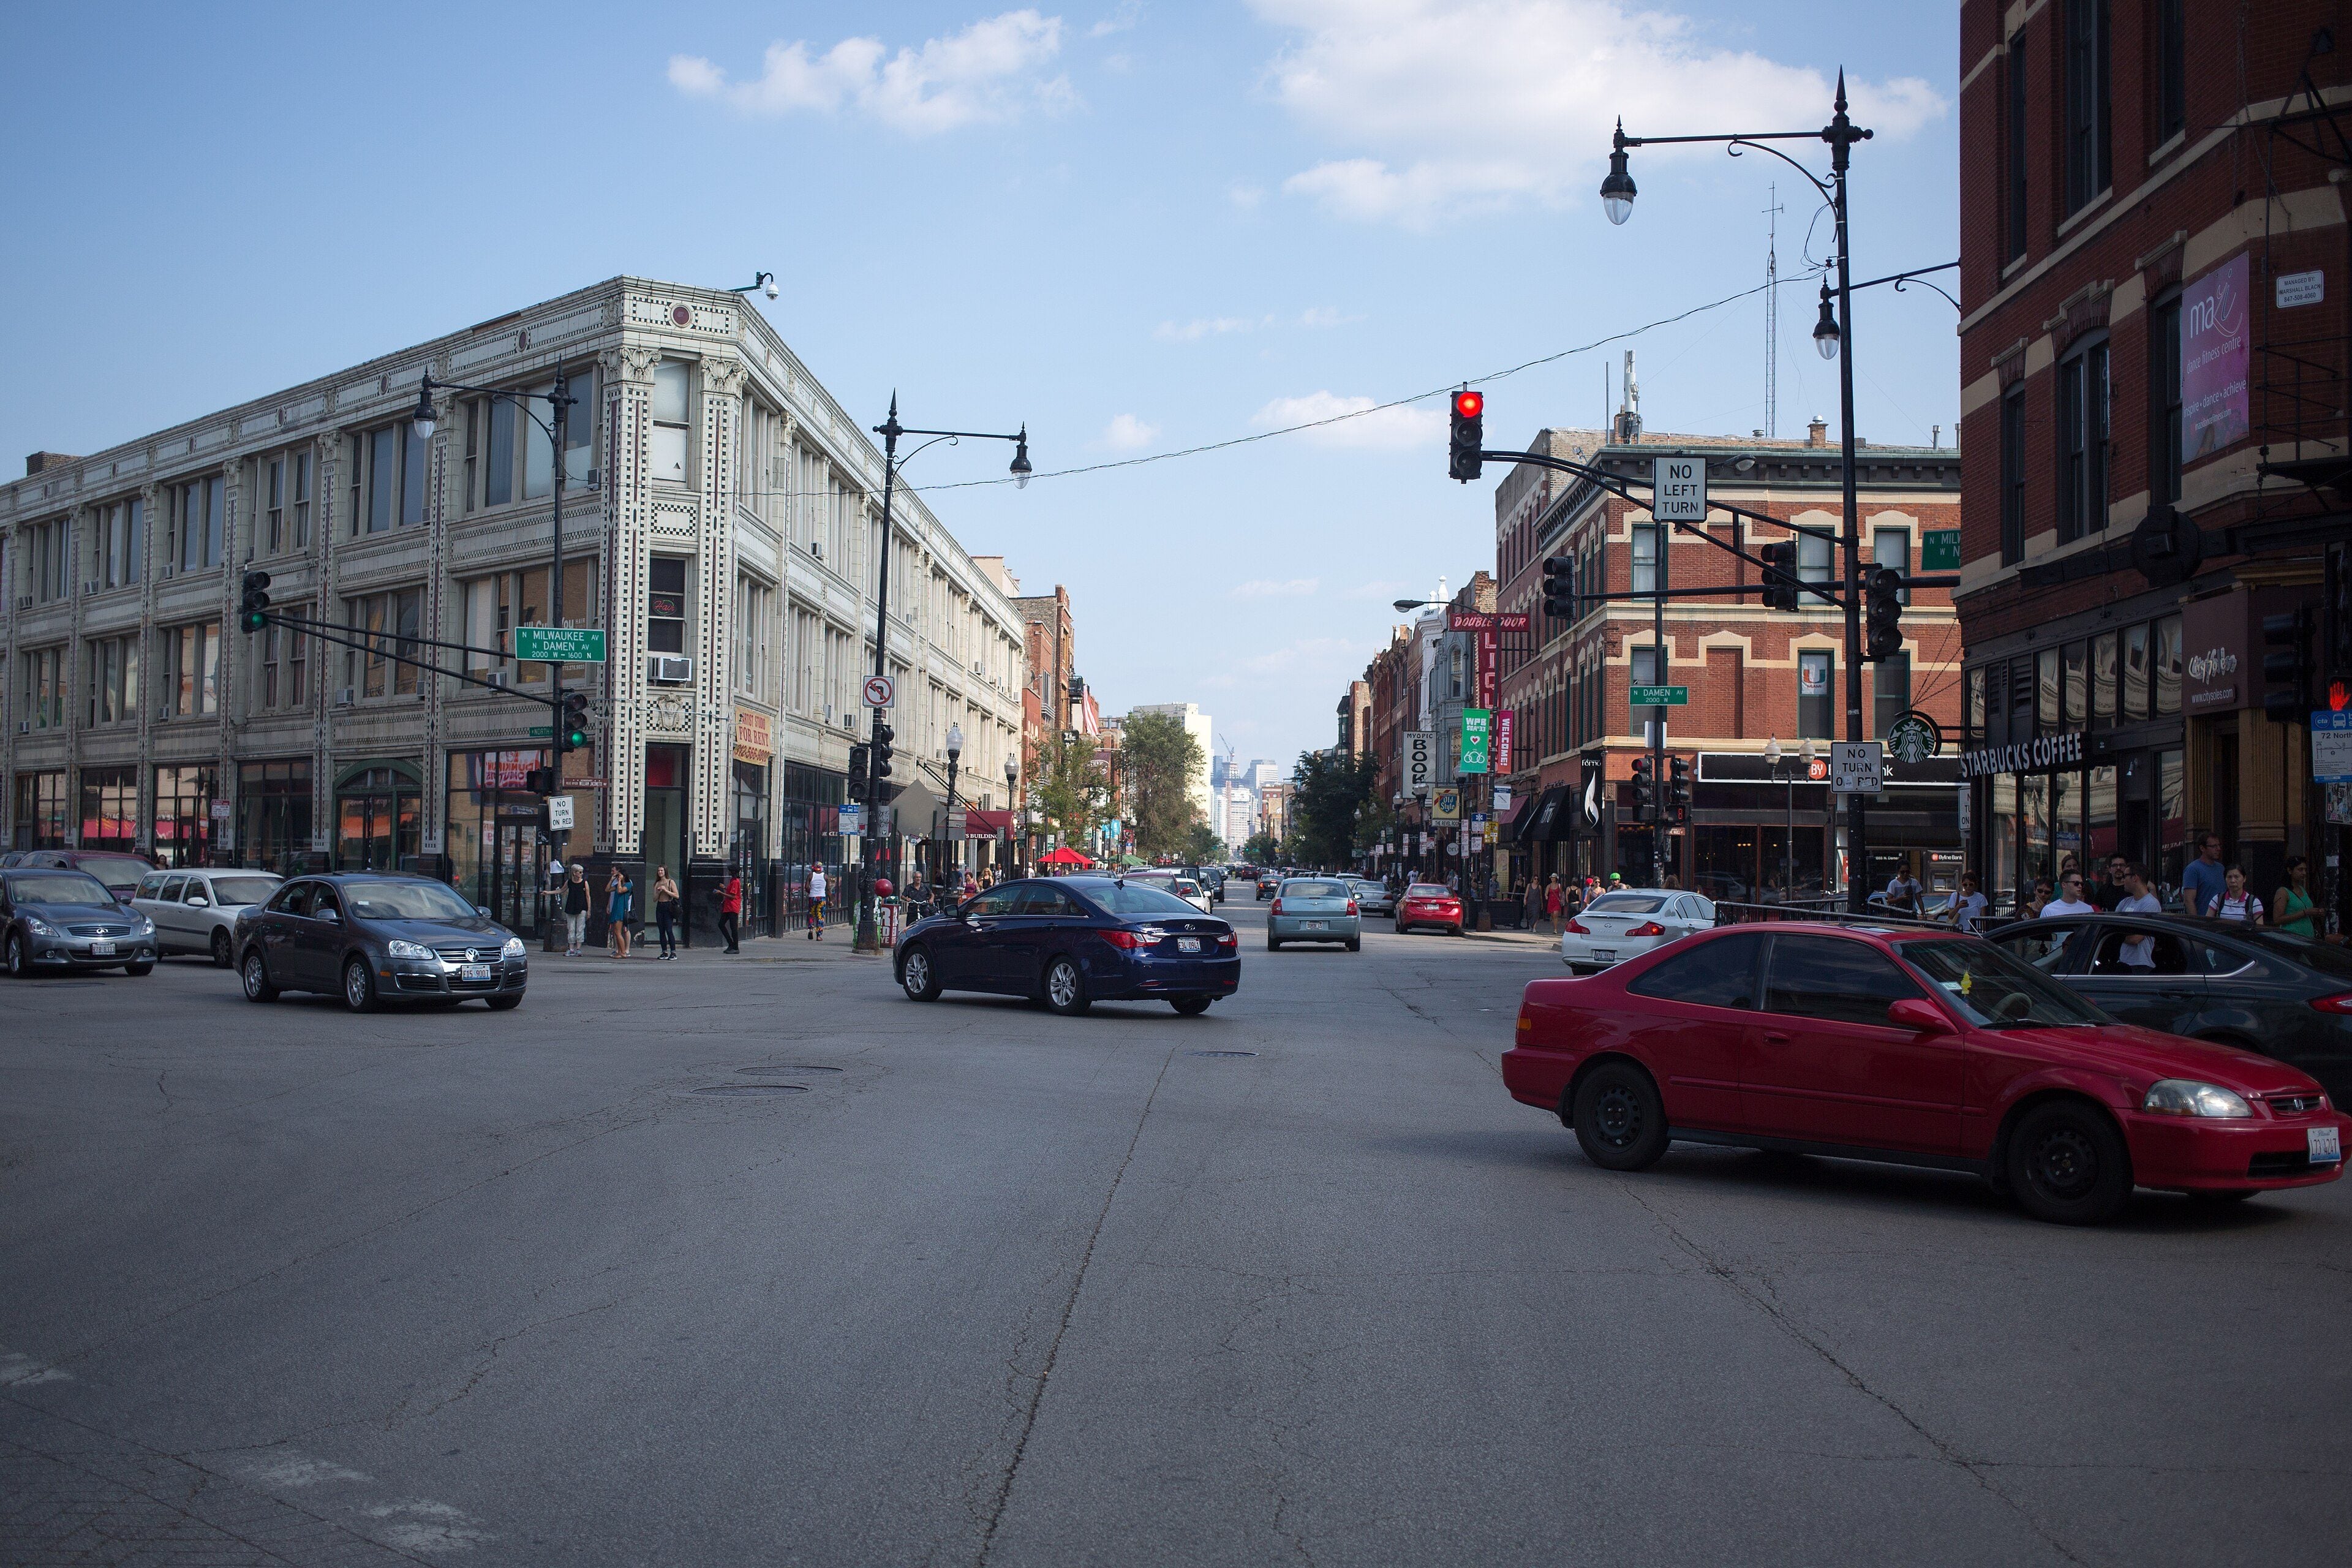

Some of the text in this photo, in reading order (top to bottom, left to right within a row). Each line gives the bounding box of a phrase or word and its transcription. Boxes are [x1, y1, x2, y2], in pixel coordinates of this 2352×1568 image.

[2284, 277, 2307, 286] MANAGED
[2284, 292, 2316, 302] 847-508-4060
[2187, 336, 2241, 374] dance fitness centre
[2184, 379, 2247, 418] inspire dance achieve
[1670, 465, 1692, 479] NO
[1664, 484, 1697, 496] LEFT
[1662, 502, 1699, 513] TURN
[1454, 616, 1494, 627] DOUBLE
[533, 630, 584, 641] MILWAUKEE
[543, 642, 575, 651] DAMEN
[2191, 688, 2234, 704] www.citysoles.com
[1465, 718, 1487, 726] WPB
[534, 727, 549, 736] NORTH
[739, 726, 769, 747] FOR RENT
[1500, 718, 1510, 766] WELCOME!
[1847, 748, 1866, 758] NO
[1960, 732, 2082, 778] STARBUCKS COFFEE
[1411, 739, 1428, 796] BOOK
[1811, 764, 1823, 775] BY
[1842, 763, 1872, 772] TURN
[1440, 803, 1455, 813] Style
[1678, 808, 1683, 820] 8
[476, 970, 489, 978] 9007
